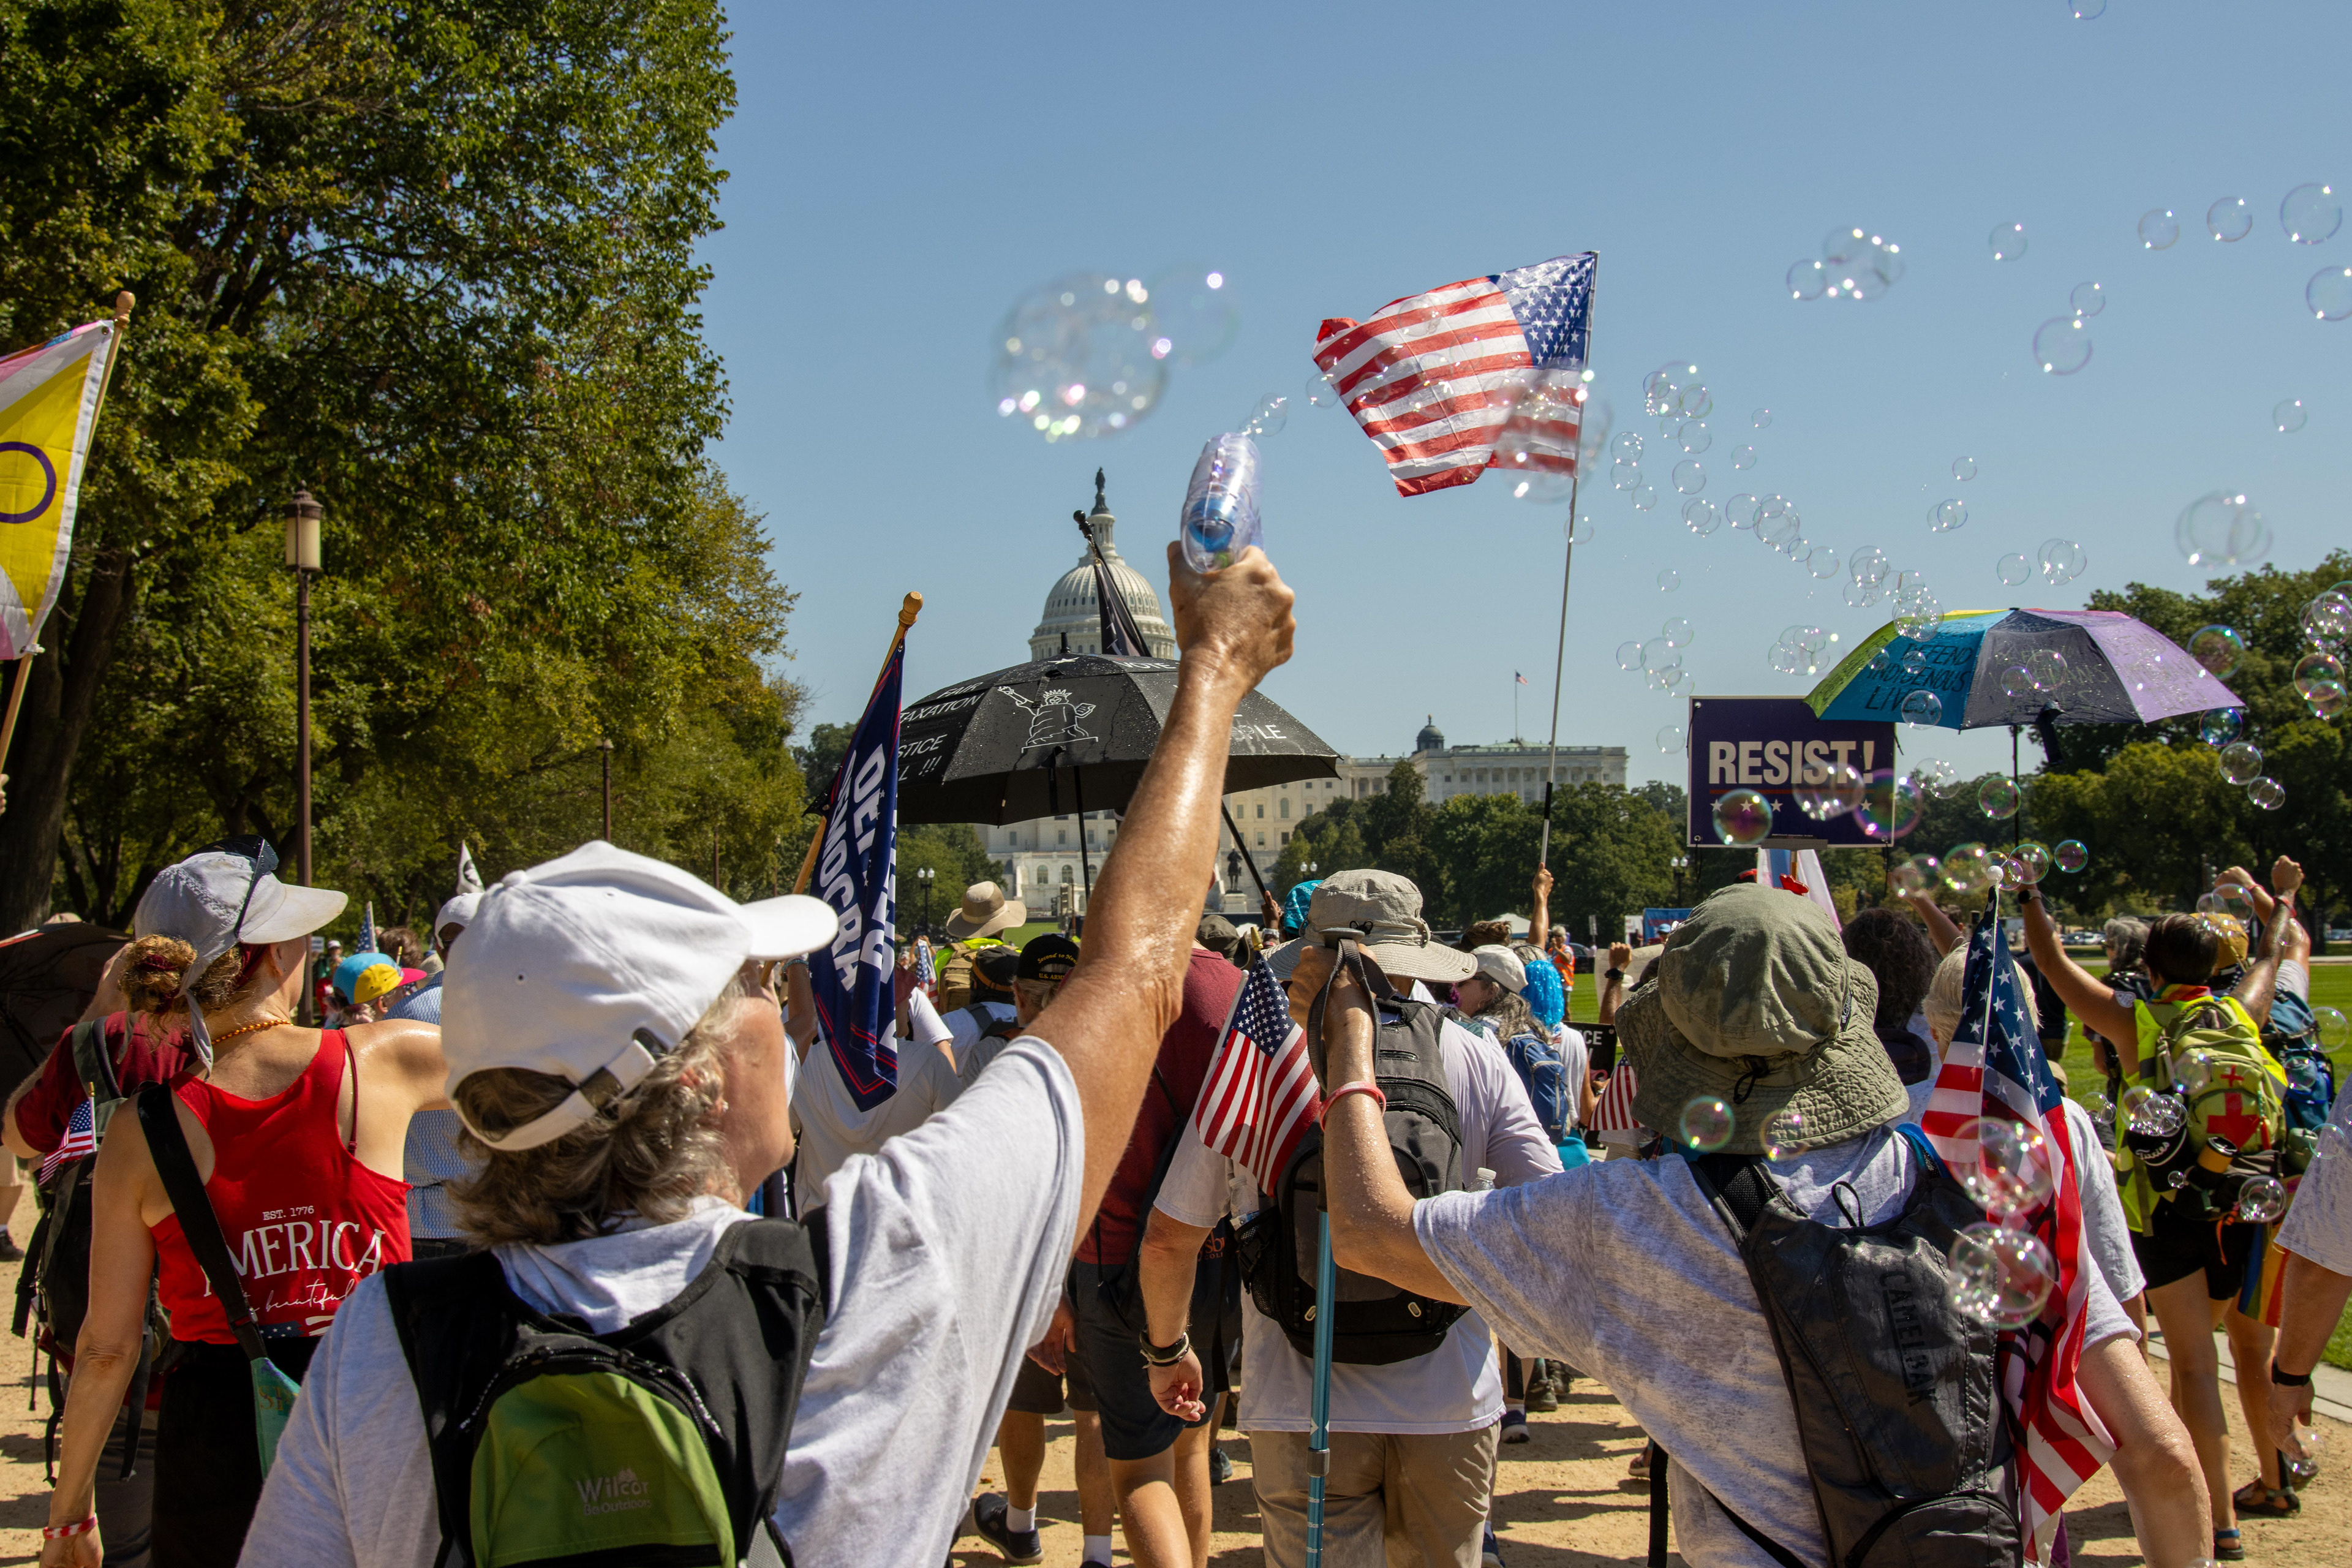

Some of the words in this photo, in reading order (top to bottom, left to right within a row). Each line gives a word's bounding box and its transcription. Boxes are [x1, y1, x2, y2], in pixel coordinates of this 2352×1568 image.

[1901, 643, 1973, 666] DEFEND
[937, 682, 984, 699] FAIR
[1866, 662, 1971, 692] INDIGENOUS
[900, 692, 985, 724] TAXATION
[898, 734, 948, 758] STICE
[1709, 740, 1875, 785] RESIST!
[819, 749, 862, 992] DEMOCRA
[1038, 952, 1057, 964] Second
[1065, 954, 1077, 964] Non
[262, 1209, 287, 1221] EST.
[290, 1205, 315, 1217] 1776
[204, 1220, 386, 1297] MERICA
[1879, 1271, 1937, 1408] CAMELBAK
